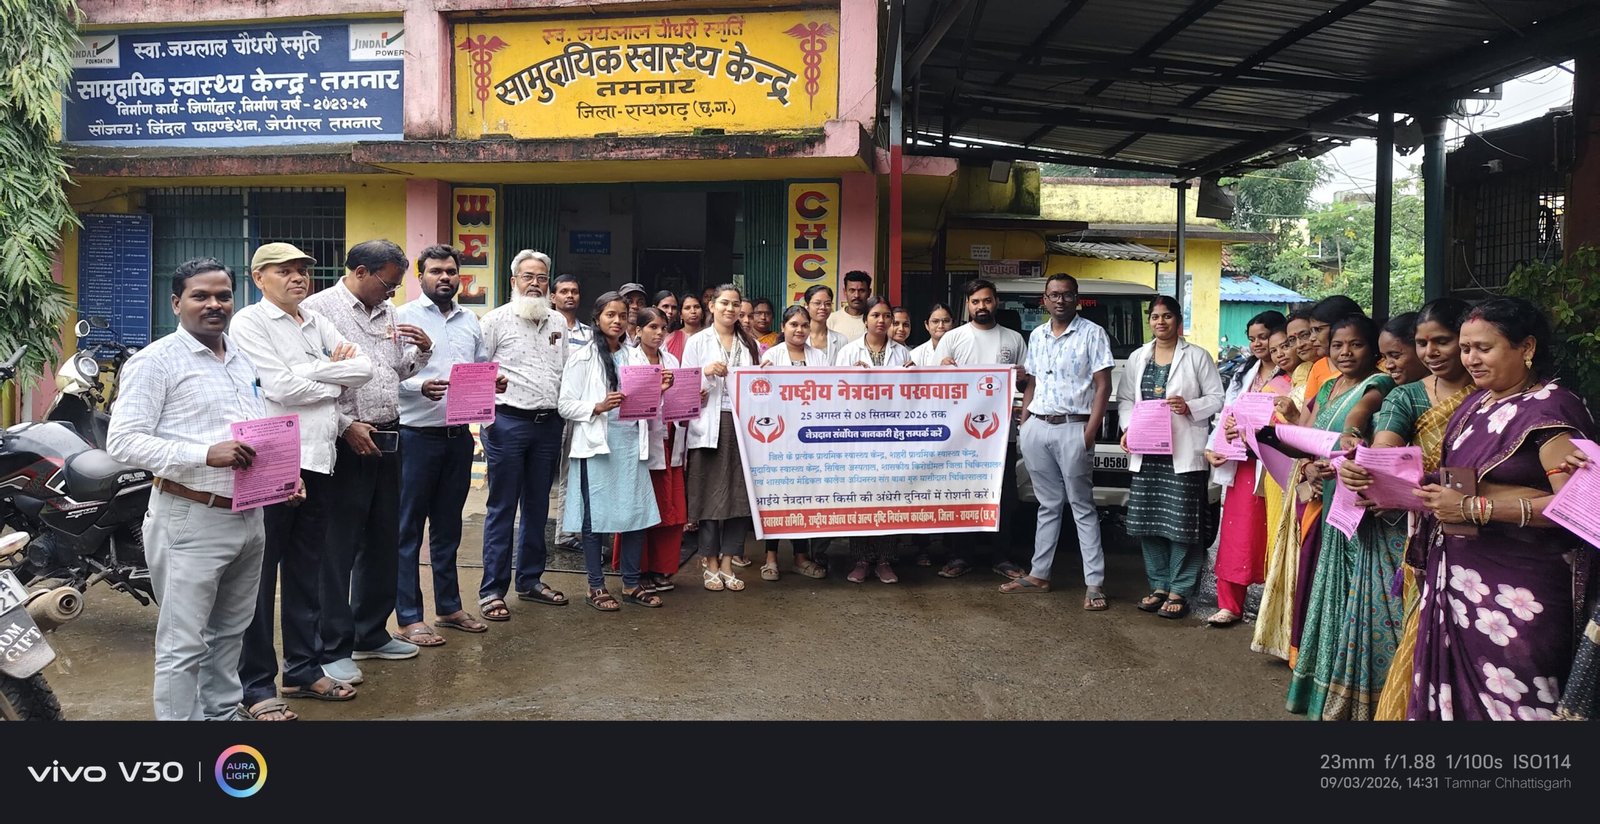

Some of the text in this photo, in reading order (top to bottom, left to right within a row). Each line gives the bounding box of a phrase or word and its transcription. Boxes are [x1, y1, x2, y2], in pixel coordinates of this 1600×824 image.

[167, 40, 227, 58] जयलाल
[232, 32, 277, 55] चौधरी
[281, 30, 321, 60] स्मृति
[352, 39, 386, 51] JINDAL
[495, 41, 797, 106] सामुदायिक स्वास्थ्य केन्द्र
[76, 72, 165, 104] सामुदायिक
[169, 74, 245, 97] स्वास्थ्य
[596, 79, 695, 98] तमनार
[116, 100, 152, 116] निर्माण
[147, 119, 186, 136] जिंदल
[265, 114, 322, 132] जेपीएल
[328, 116, 383, 132] तमनार
[779, 379, 834, 406] राष्ट्रीय
[837, 379, 894, 401] नेत्रदान
[899, 383, 969, 405] पखवाड़ा
[800, 409, 947, 420] 25 अगस्त से 08 सितम्बर 2026 तक
[805, 429, 831, 439] नेत्रदान
[860, 427, 892, 438] जानकारी
[893, 427, 905, 440] हेतु
[905, 427, 929, 438] सम्पर्क
[930, 427, 943, 437] करें
[750, 464, 777, 476] मुदायिक
[782, 493, 812, 505] नेत्रदान
[815, 495, 831, 504] कर
[833, 491, 857, 503] किसी
[860, 490, 873, 503] की
[876, 490, 901, 501] अंधेरी
[933, 489, 942, 500] में
[945, 488, 971, 500] रोशनी
[974, 488, 989, 499] करें
[6, 626, 41, 662] GIFT
